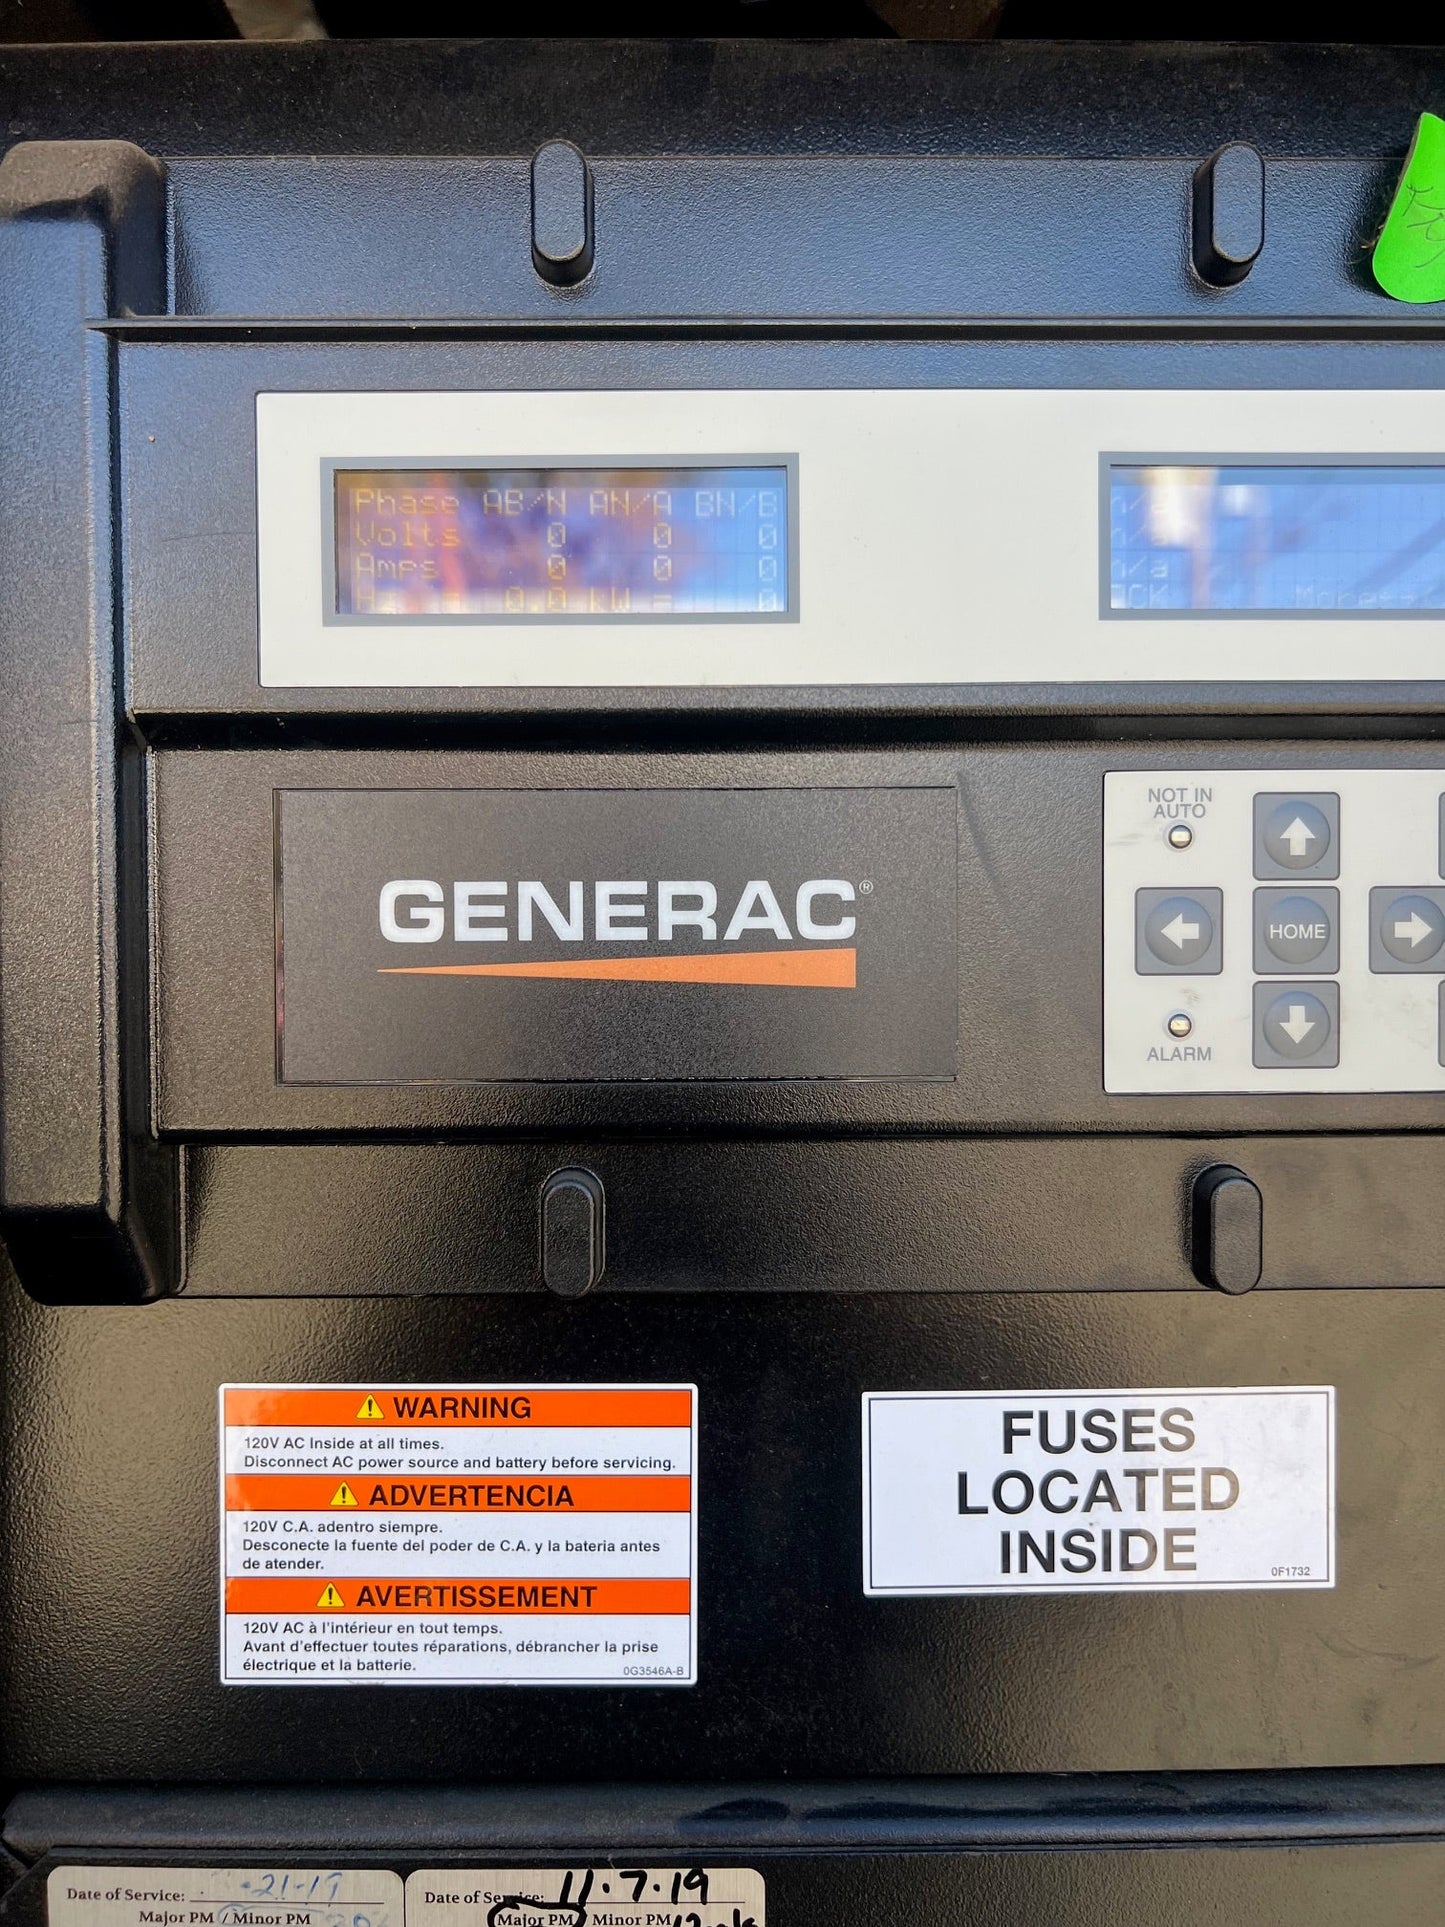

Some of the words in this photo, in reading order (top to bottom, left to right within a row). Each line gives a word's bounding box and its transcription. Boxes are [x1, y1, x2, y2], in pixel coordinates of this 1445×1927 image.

[355, 488, 460, 516] Phase
[482, 489, 567, 516] AB/N
[589, 489, 673, 517] AN/A
[695, 490, 778, 518] BN/B
[355, 519, 460, 547] Volts
[547, 521, 567, 548] 0
[653, 522, 673, 549] 0
[758, 523, 778, 550] 0
[355, 551, 438, 579] Amps
[547, 554, 567, 581] 0
[653, 555, 673, 582] 0
[758, 556, 778, 582] 0
[758, 588, 778, 612] 0
[1148, 788, 1188, 803] NOT
[1195, 788, 1212, 802] IN
[1154, 804, 1206, 818] AUTO
[1269, 924, 1326, 939] HOME
[1147, 1047, 1212, 1062] ALARM
[393, 1396, 532, 1419] WARNING
[1001, 1407, 1196, 1455] FUSES
[244, 1437, 280, 1450] 120V
[283, 1438, 305, 1450] AC
[309, 1437, 355, 1450] Inside
[359, 1438, 374, 1450] at
[377, 1437, 395, 1450] all
[399, 1438, 445, 1450] times.
[244, 1455, 329, 1469] Disconnect
[332, 1456, 354, 1469] AC
[358, 1458, 404, 1471] power
[407, 1458, 459, 1469] source
[463, 1457, 491, 1469] and
[496, 1456, 547, 1472] battery
[551, 1456, 599, 1469] before
[603, 1457, 676, 1472] servicing.
[368, 1484, 575, 1507] ADVERTENCIA
[957, 1466, 1240, 1515] LOCATED
[243, 1520, 278, 1533] 120V
[282, 1520, 313, 1533] C.A.
[317, 1520, 374, 1533] adentro
[378, 1521, 443, 1536] siempre.
[242, 1538, 330, 1552] Desconecte
[334, 1539, 347, 1551] la
[351, 1539, 399, 1551] fuente
[402, 1540, 425, 1551] del
[429, 1540, 474, 1554] poder
[477, 1540, 495, 1552] de
[499, 1540, 530, 1552] C.A.
[534, 1543, 543, 1555] y
[548, 1540, 560, 1552] la
[565, 1540, 616, 1552] bateria
[620, 1541, 660, 1552] antes
[1000, 1527, 1198, 1574] INSIDE
[242, 1557, 260, 1570] de
[264, 1558, 324, 1570] atender.
[355, 1585, 597, 1608] AVERTISSEMENT
[243, 1621, 278, 1634] 120V
[282, 1622, 304, 1634] AC
[309, 1620, 317, 1634] à
[322, 1621, 392, 1634] l'intérieur
[396, 1624, 415, 1634] en
[419, 1622, 449, 1634] tout
[453, 1623, 502, 1637] temps.
[243, 1640, 285, 1653] Avant
[290, 1640, 369, 1653] d'effectuer
[373, 1640, 419, 1653] toutes
[423, 1640, 512, 1656] réparations,
[515, 1640, 600, 1653] débrancher
[604, 1640, 617, 1653] la
[621, 1640, 659, 1656] prise
[242, 1658, 317, 1673] électrique
[321, 1660, 335, 1671] et
[339, 1659, 351, 1671] la
[356, 1659, 417, 1671] batterie.
[67, 1887, 101, 1902] Date
[105, 1887, 121, 1900] of
[124, 1889, 185, 1903] Service:
[424, 1891, 460, 1904] Date
[463, 1890, 481, 1903] of
[139, 1909, 185, 1927] Major
[189, 1912, 214, 1923] PM
[233, 1912, 282, 1925] Minor
[286, 1913, 311, 1925] PM
[497, 1914, 545, 1927] Major
[548, 1914, 574, 1926] PM
[593, 1914, 642, 1926] Minor
[646, 1914, 672, 1926] PM
